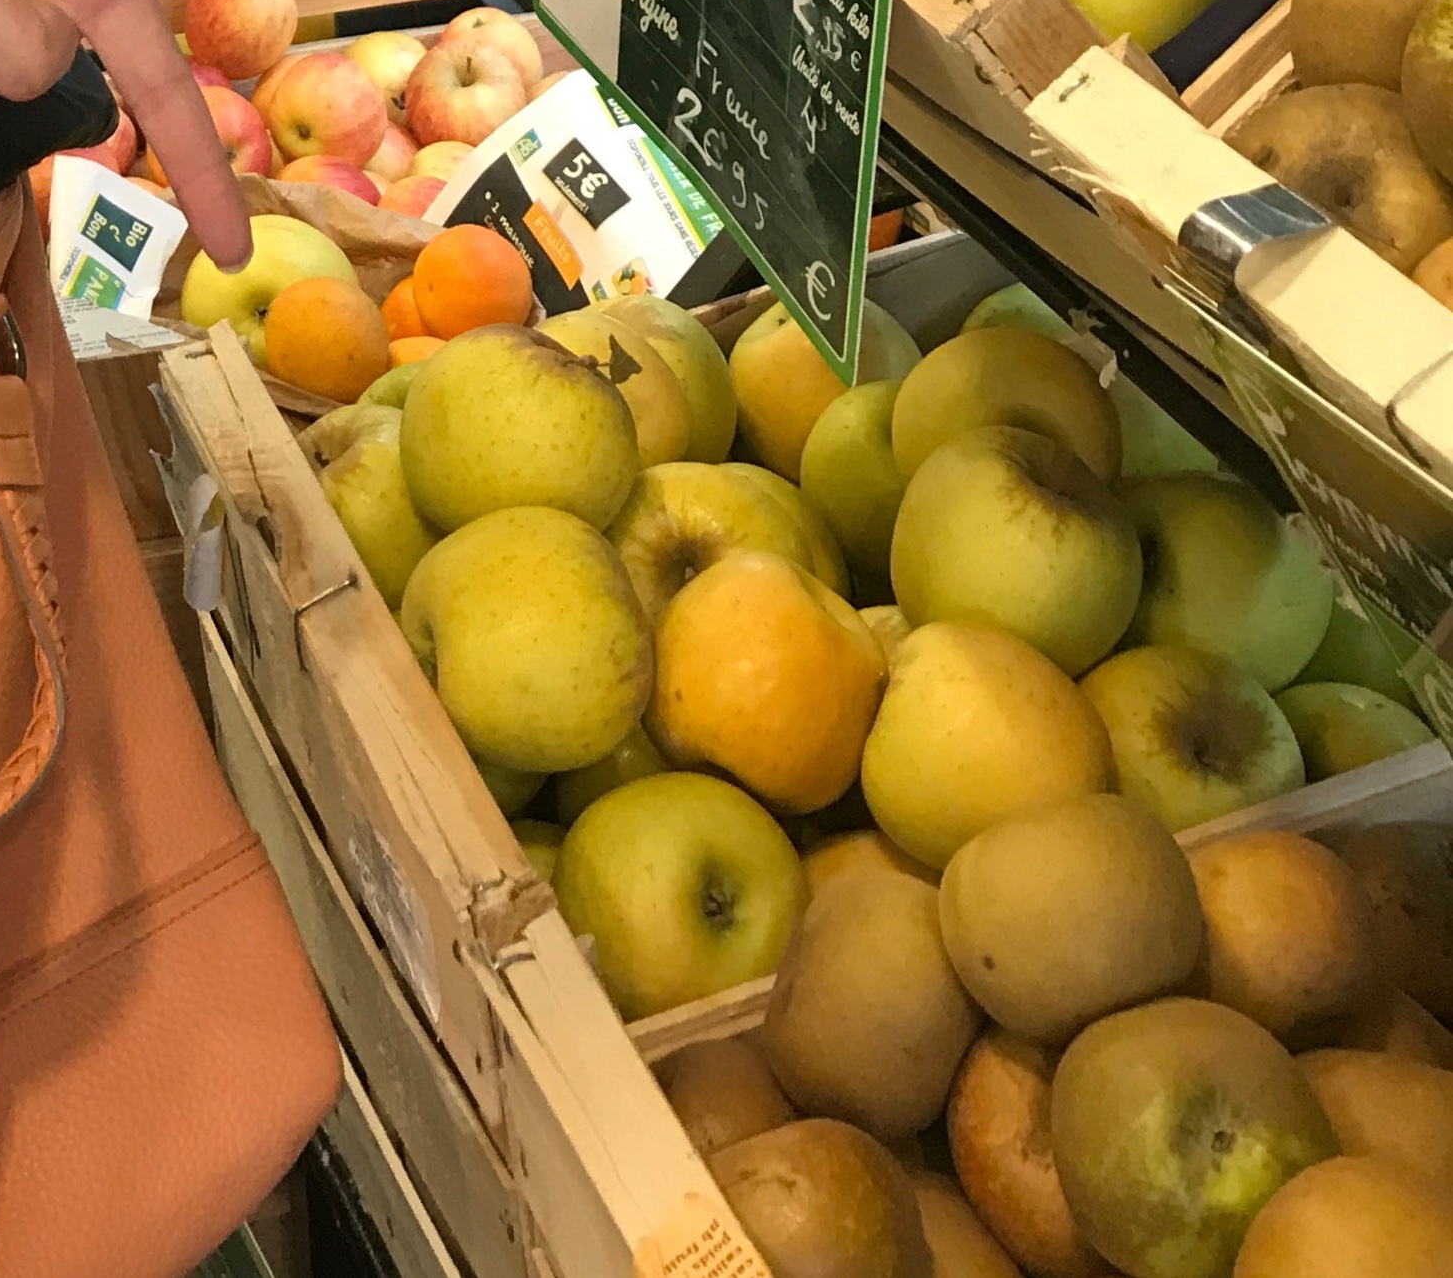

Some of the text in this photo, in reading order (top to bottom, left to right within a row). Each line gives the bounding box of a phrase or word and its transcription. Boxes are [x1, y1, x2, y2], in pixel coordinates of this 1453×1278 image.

[847, 10, 870, 41] kilo
[792, 44, 819, 89] Unité
[820, 80, 834, 105] de
[834, 101, 861, 136] vente
[562, 151, 609, 199] 5€
[85, 211, 108, 240] Bon
[125, 221, 148, 248] Bio
[533, 216, 572, 264] Fruits
[674, 221, 689, 240] SANS
[805, 260, 836, 321] €
